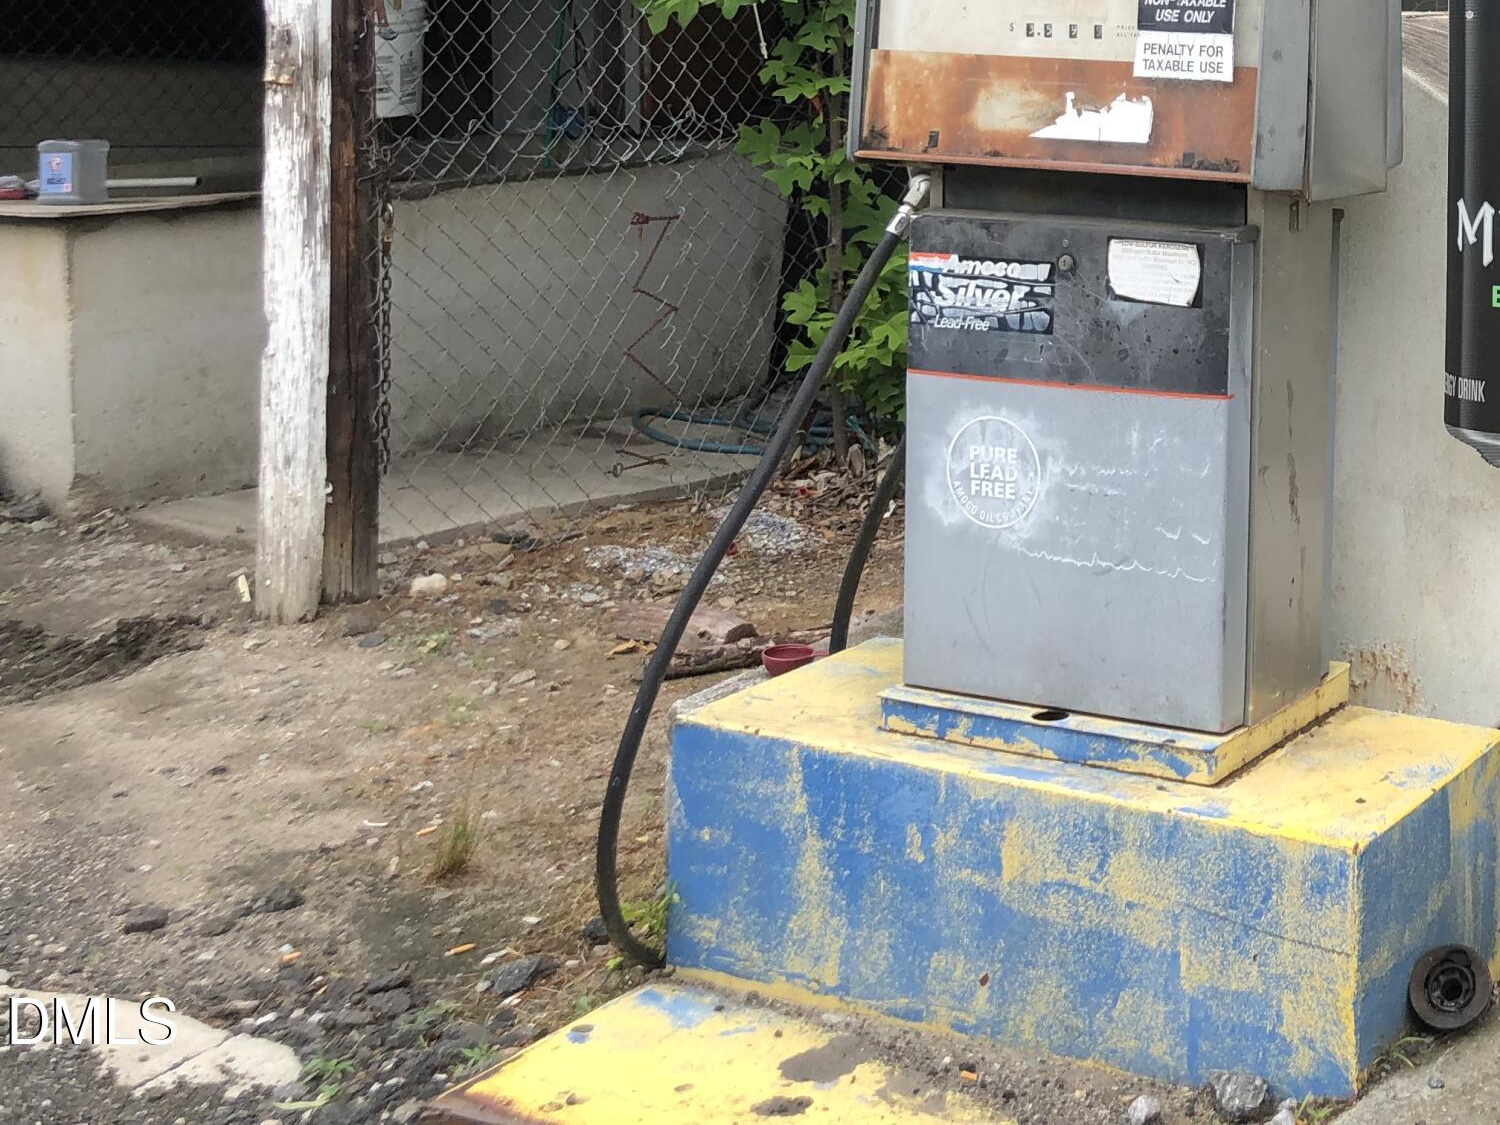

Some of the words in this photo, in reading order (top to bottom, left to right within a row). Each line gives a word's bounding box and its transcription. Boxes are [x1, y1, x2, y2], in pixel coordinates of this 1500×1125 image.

[1155, 8, 1181, 22] USE
[1183, 10, 1215, 23] ONLY
[1143, 42, 1194, 57] PENALTY
[1199, 44, 1224, 58] FOR
[1142, 59, 1195, 73] TAXABLE
[1199, 61, 1224, 74] USE
[942, 254, 1022, 278] Amoco
[934, 314, 990, 331] Lead-Free
[1457, 377, 1486, 403] DRINK
[969, 445, 1018, 464] PURE
[970, 461, 1018, 482] LEAD
[971, 479, 1016, 500] FREE
[952, 480, 978, 516] AMOCO
[979, 509, 995, 523] OIL
